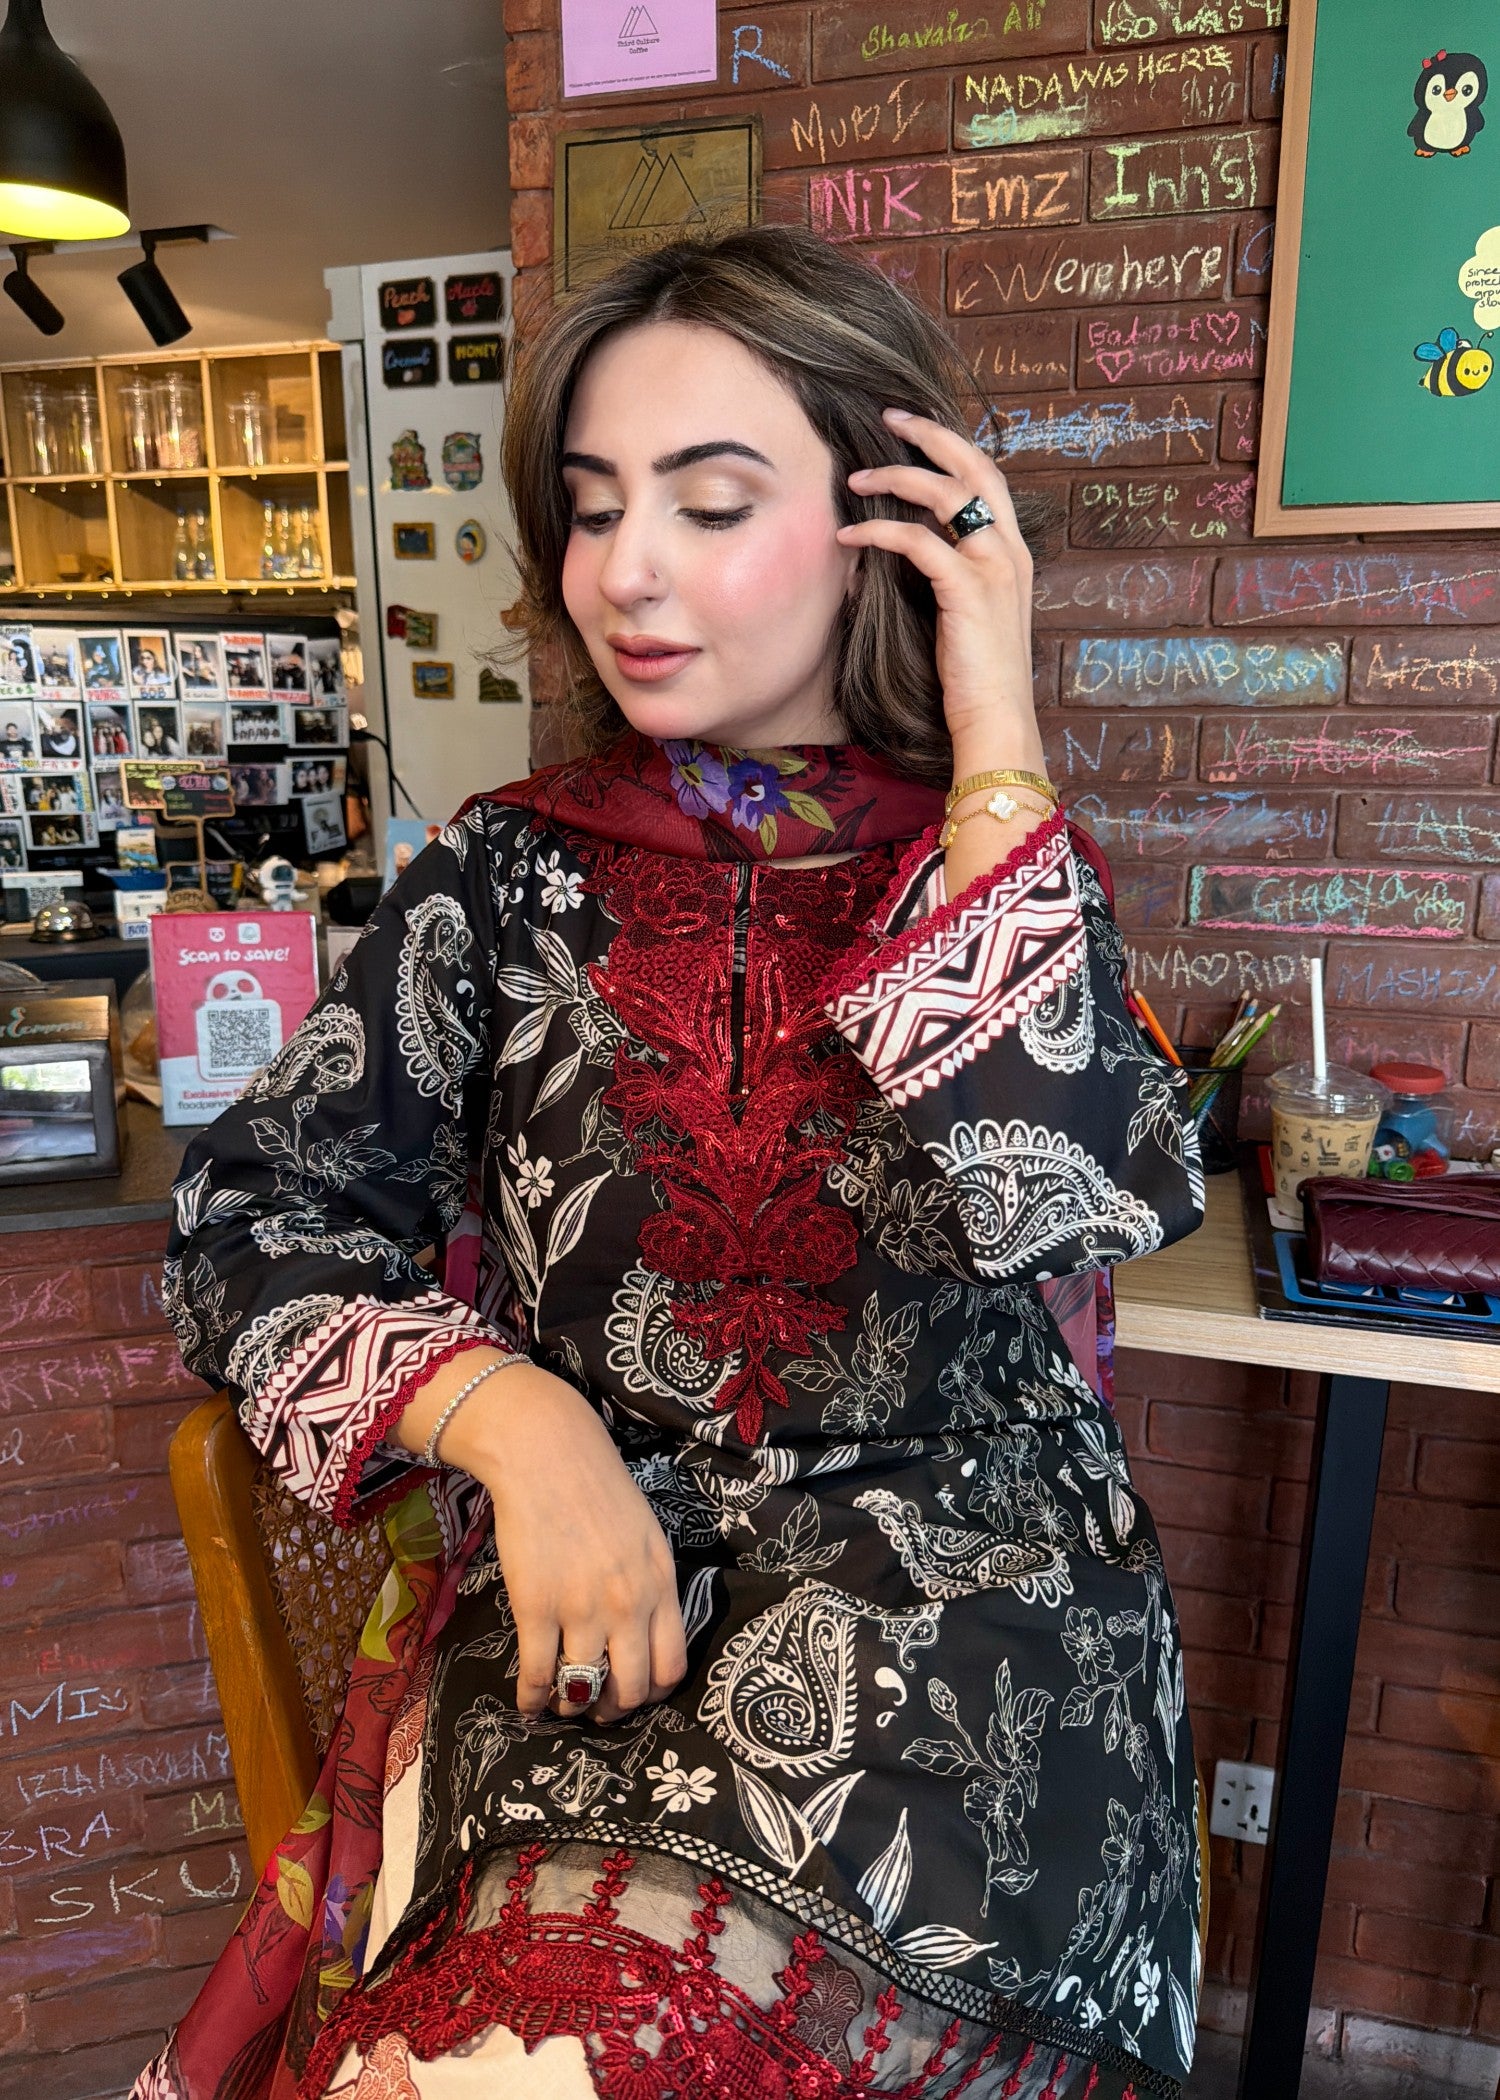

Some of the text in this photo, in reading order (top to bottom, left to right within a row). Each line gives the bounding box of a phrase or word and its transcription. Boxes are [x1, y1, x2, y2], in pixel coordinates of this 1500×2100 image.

[636, 37, 660, 46] Culture
[629, 46, 649, 55] Coffee
[732, 25, 791, 84] R
[179, 946, 291, 966] Scan to save!
